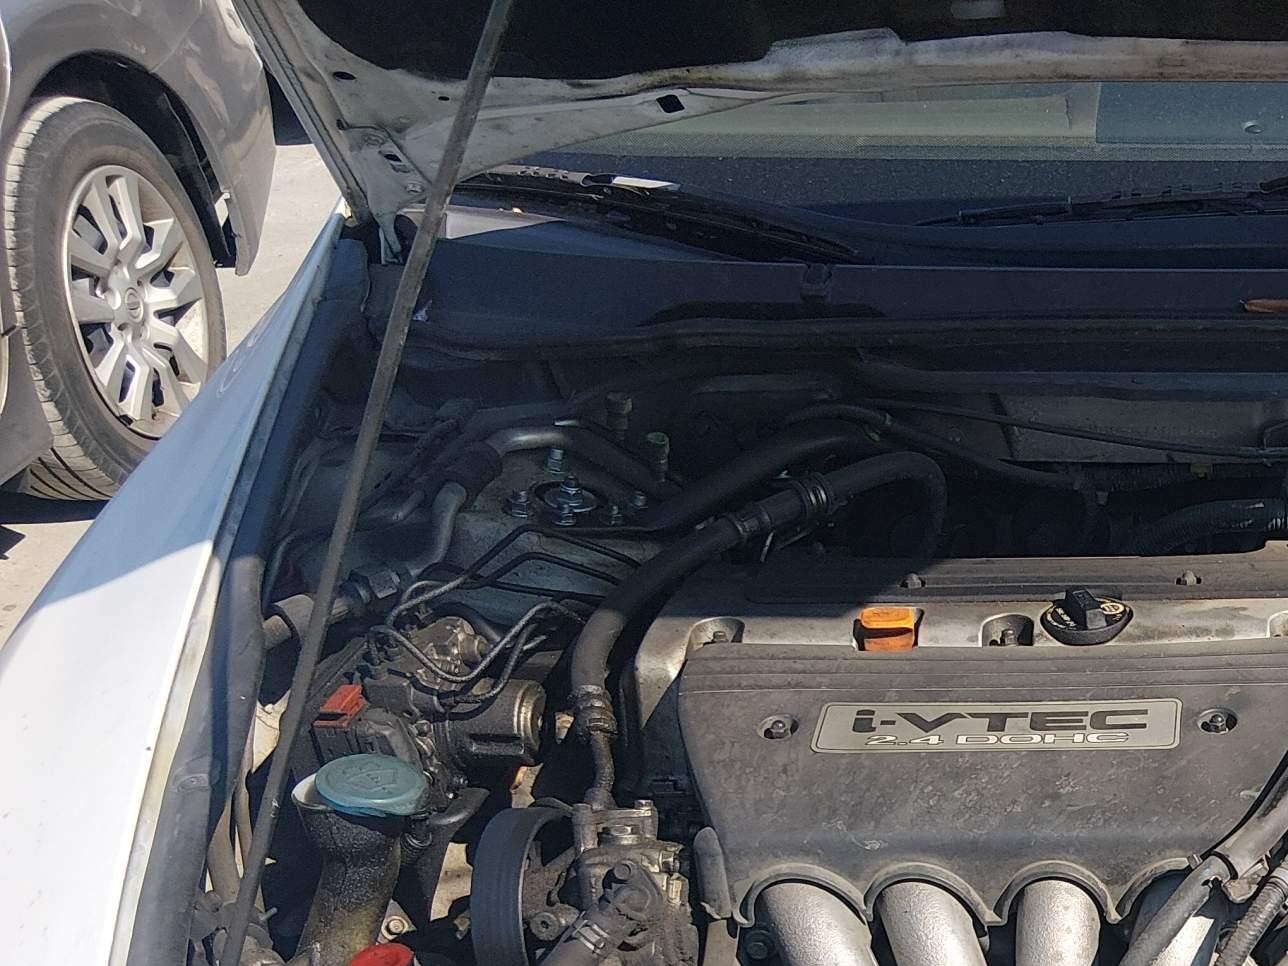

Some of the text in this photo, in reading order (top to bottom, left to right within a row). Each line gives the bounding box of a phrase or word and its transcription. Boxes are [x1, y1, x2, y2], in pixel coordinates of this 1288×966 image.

[851, 708, 1149, 734] i-VTEC
[864, 731, 1129, 746] 2.4 DOHC
